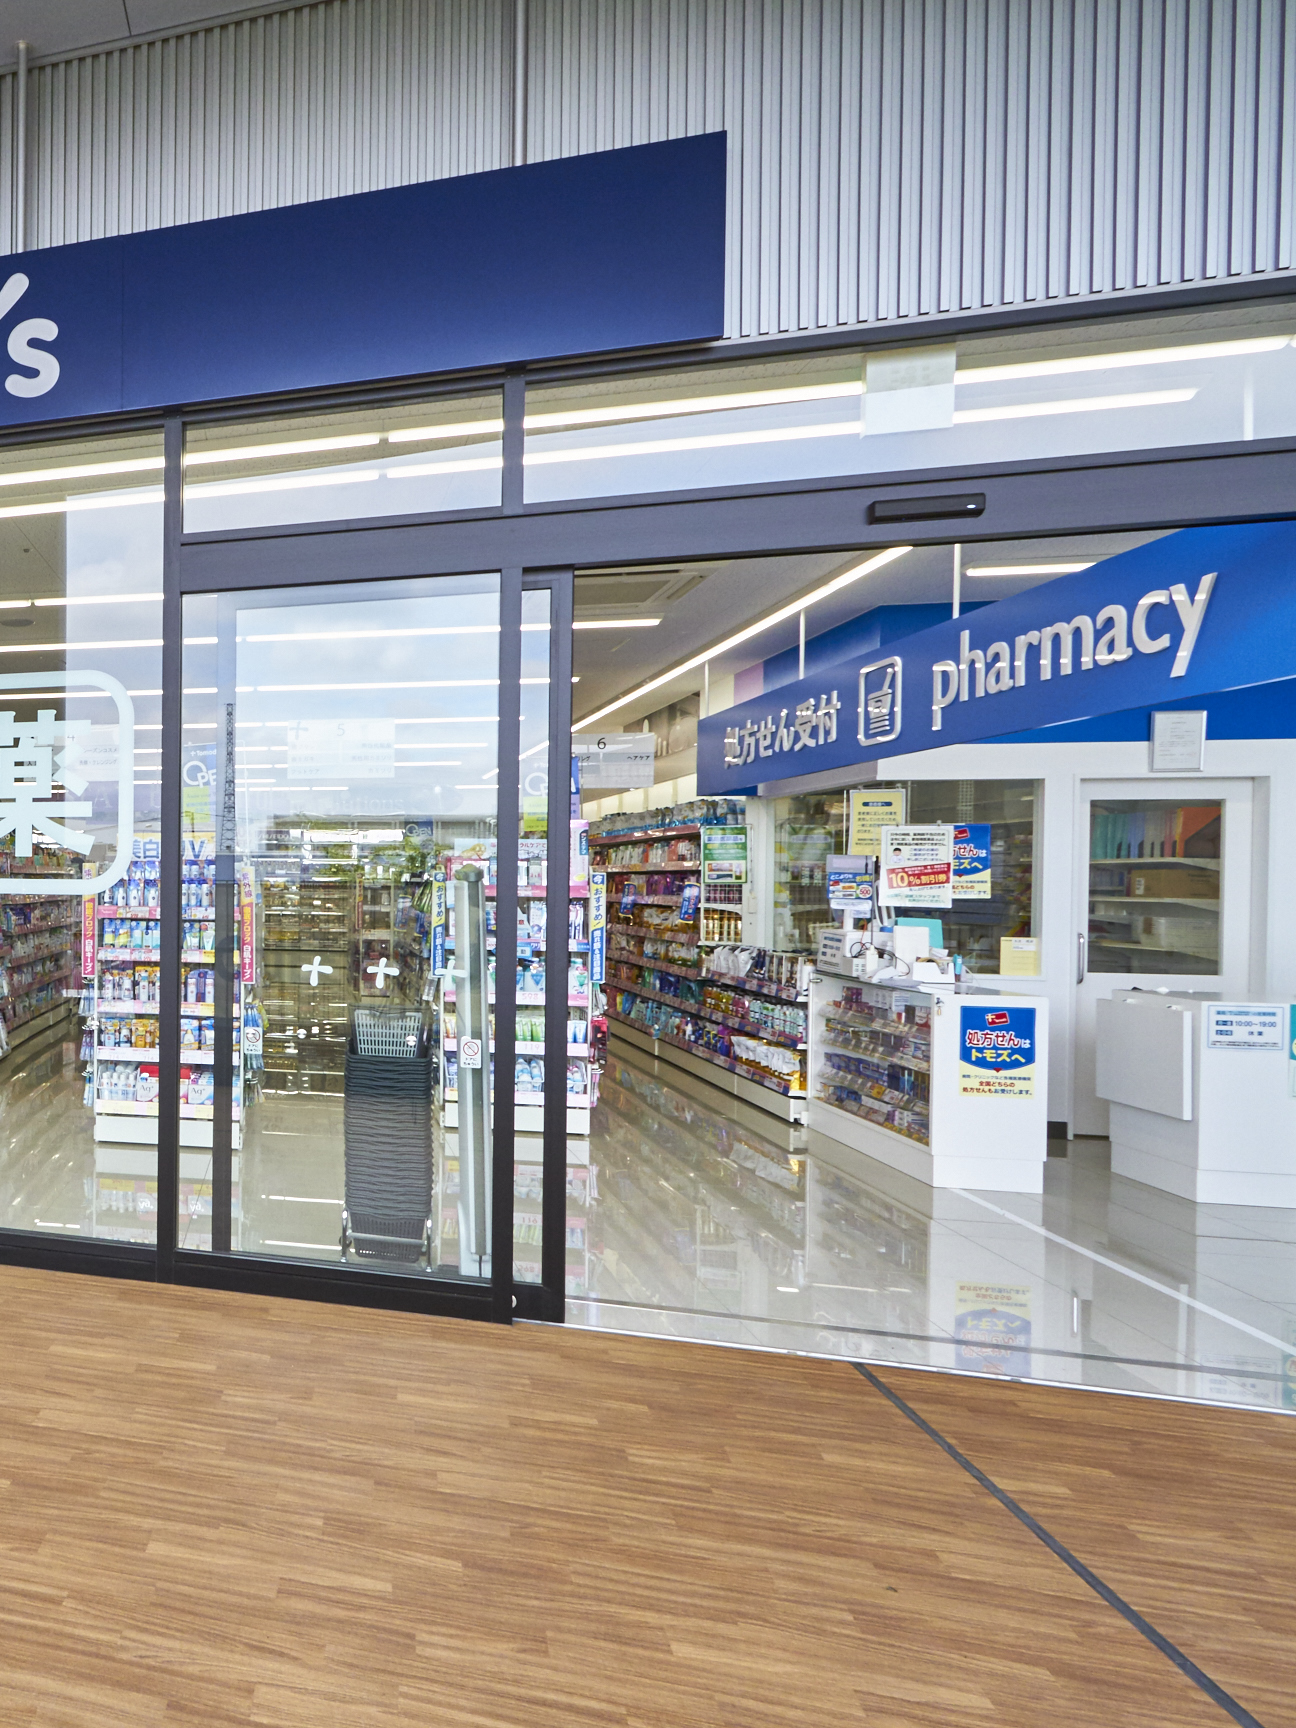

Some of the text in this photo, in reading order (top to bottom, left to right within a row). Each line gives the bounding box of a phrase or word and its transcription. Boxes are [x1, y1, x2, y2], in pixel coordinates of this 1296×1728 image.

[931, 572, 1218, 731] pharmacy
[336, 723, 345, 736] 5
[724, 689, 841, 768] 処方せん受付
[597, 737, 606, 749] 6
[966, 1029, 1031, 1049] 処方せんは
[971, 1048, 1026, 1063] トモズへ
